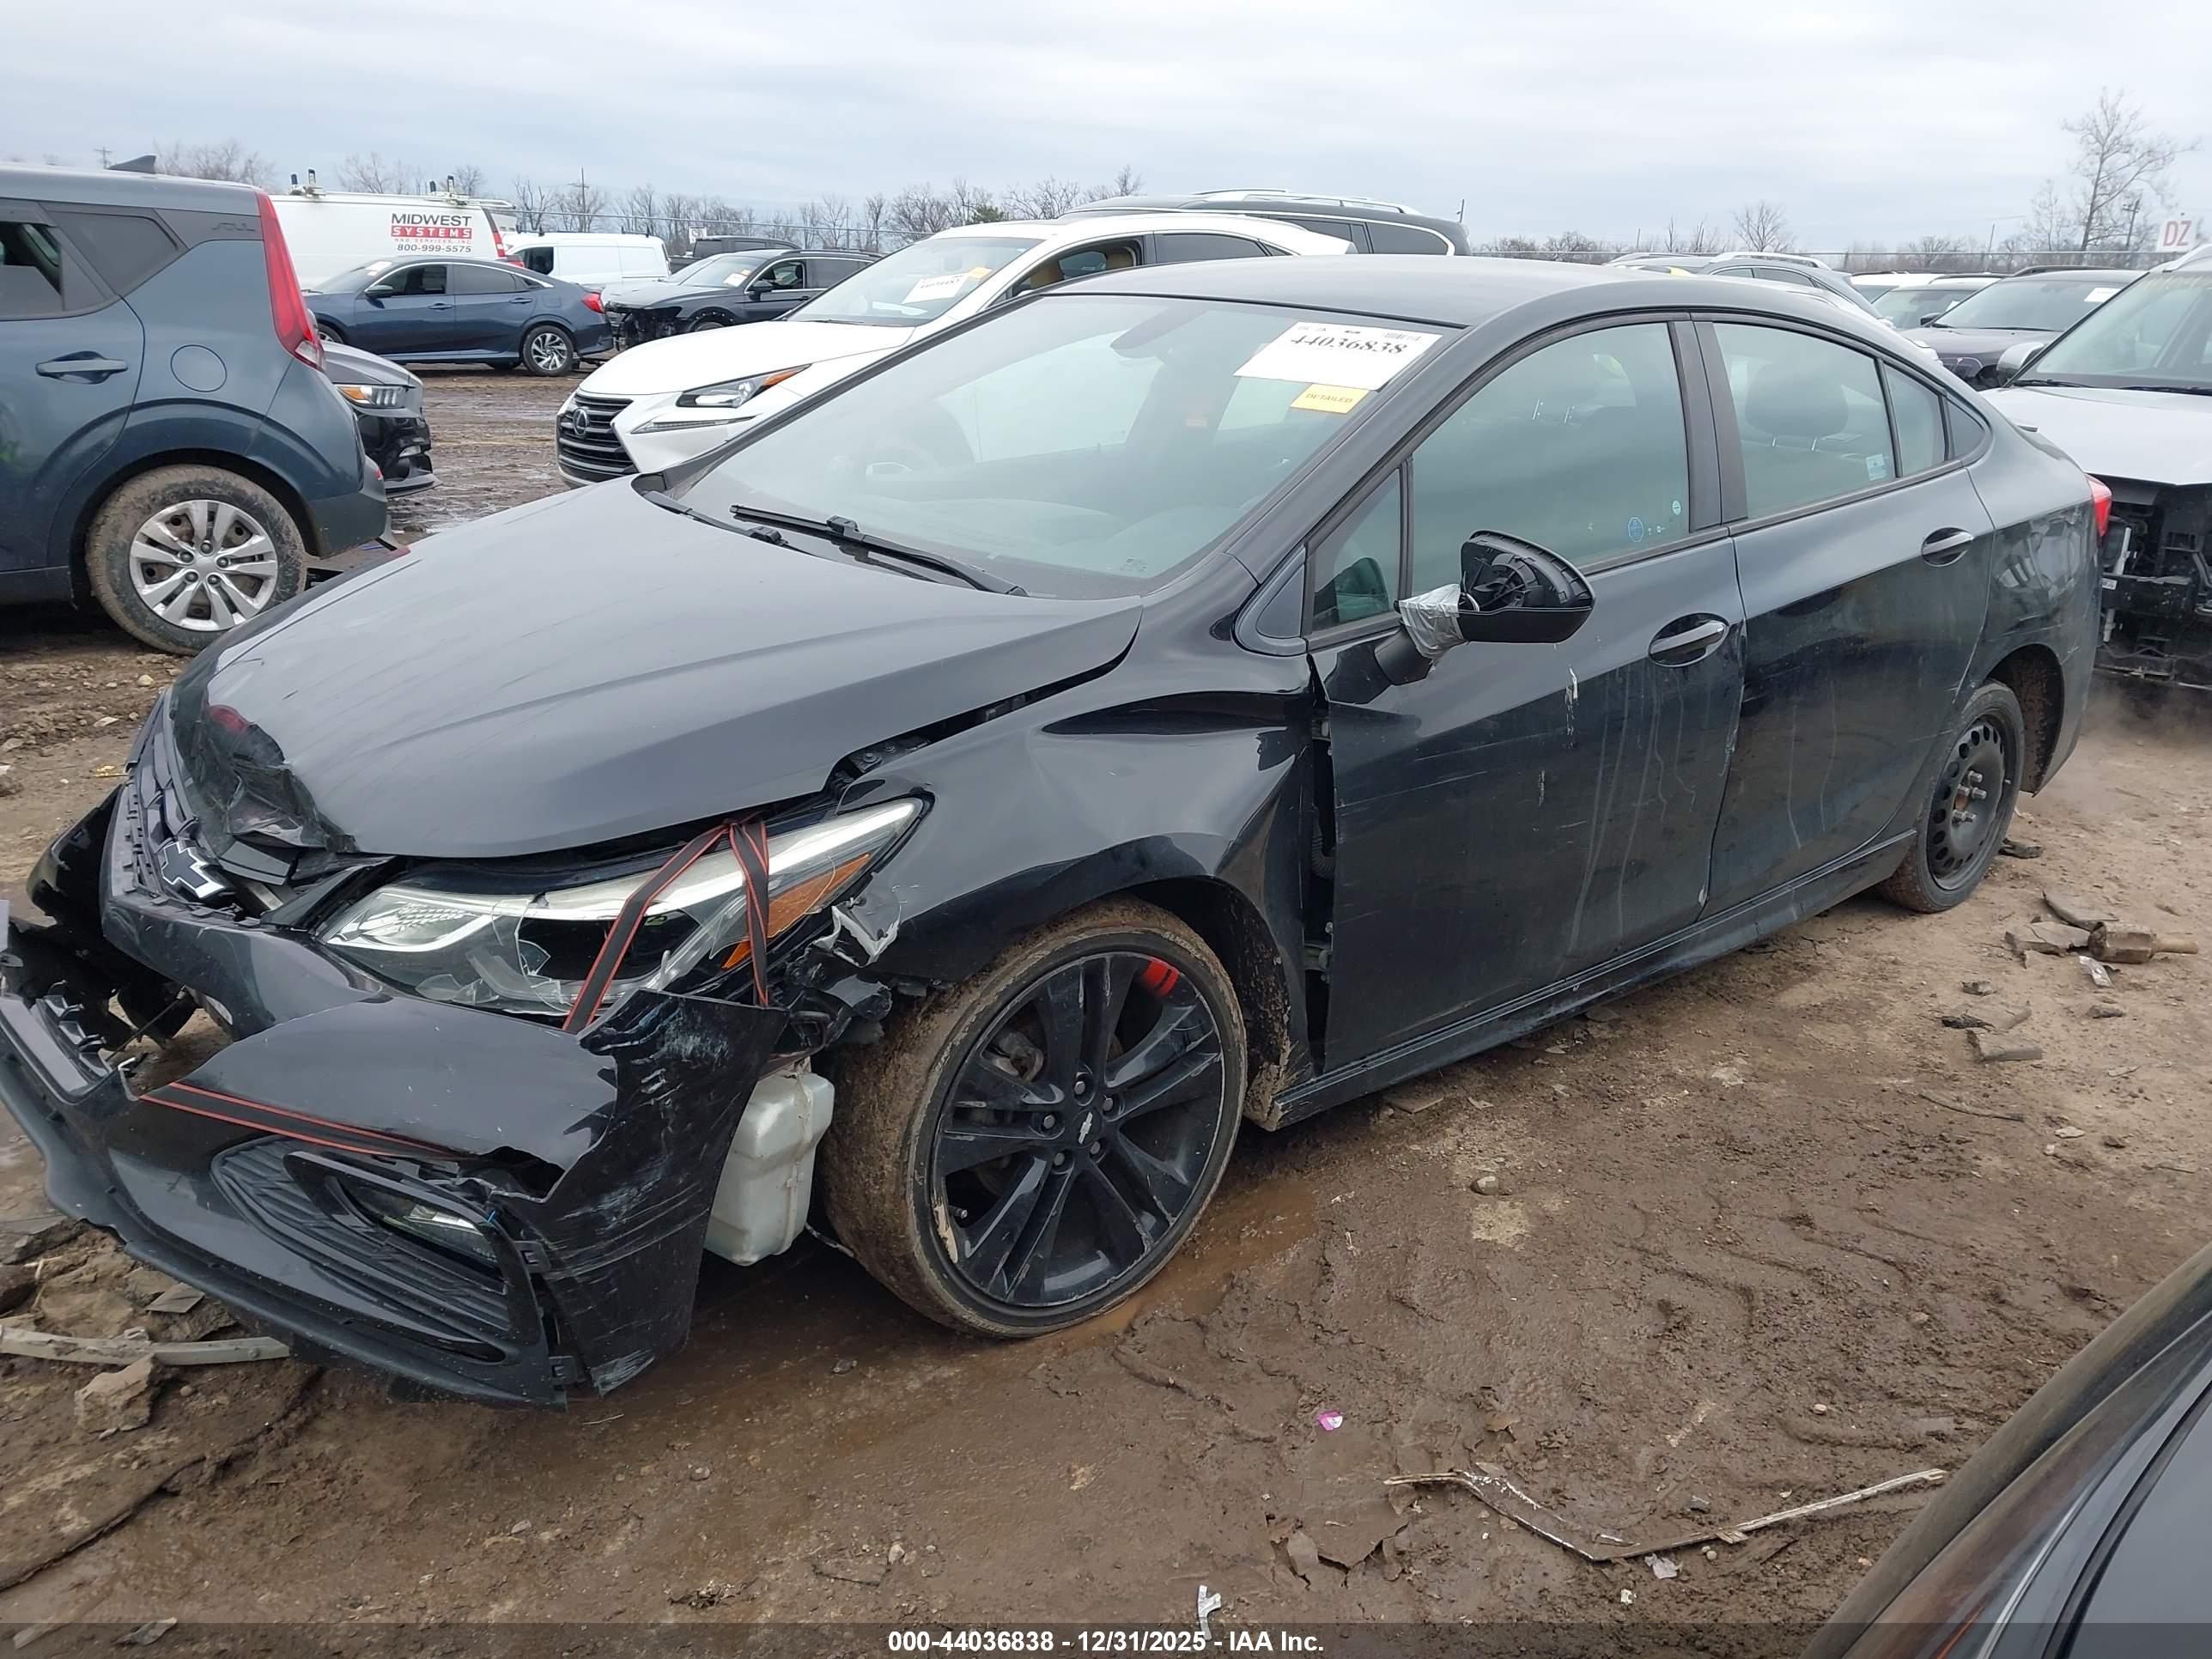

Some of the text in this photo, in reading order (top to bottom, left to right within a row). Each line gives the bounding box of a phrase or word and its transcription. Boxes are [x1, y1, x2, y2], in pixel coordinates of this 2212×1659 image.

[392, 213, 472, 227] MIDWEST
[392, 227, 471, 238] SYSTEMS
[2162, 220, 2192, 246] DZ
[397, 244, 471, 253] 800-999-5575
[1290, 334, 1407, 354] 44036838
[1304, 392, 1353, 404] DETAILED
